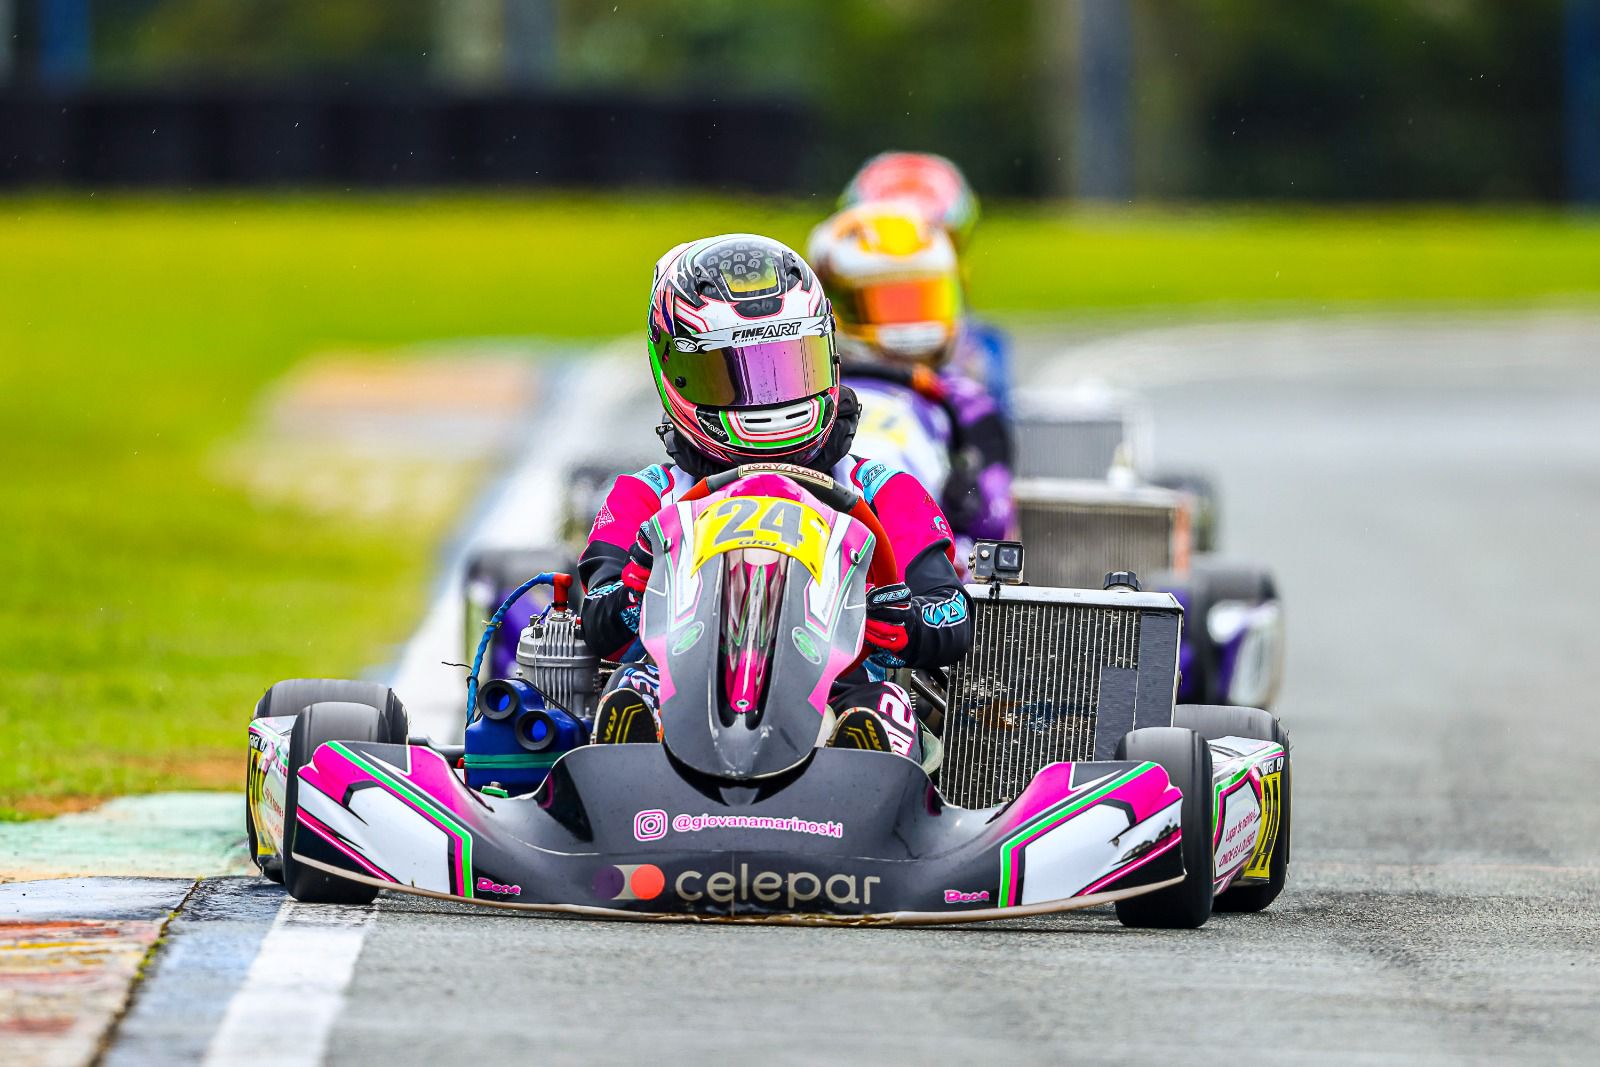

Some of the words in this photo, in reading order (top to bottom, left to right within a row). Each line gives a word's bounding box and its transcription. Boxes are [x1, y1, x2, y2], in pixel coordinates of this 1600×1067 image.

[714, 498, 804, 549] 24
[673, 813, 844, 839] @giovanamarinoski
[675, 863, 881, 909] celepar
